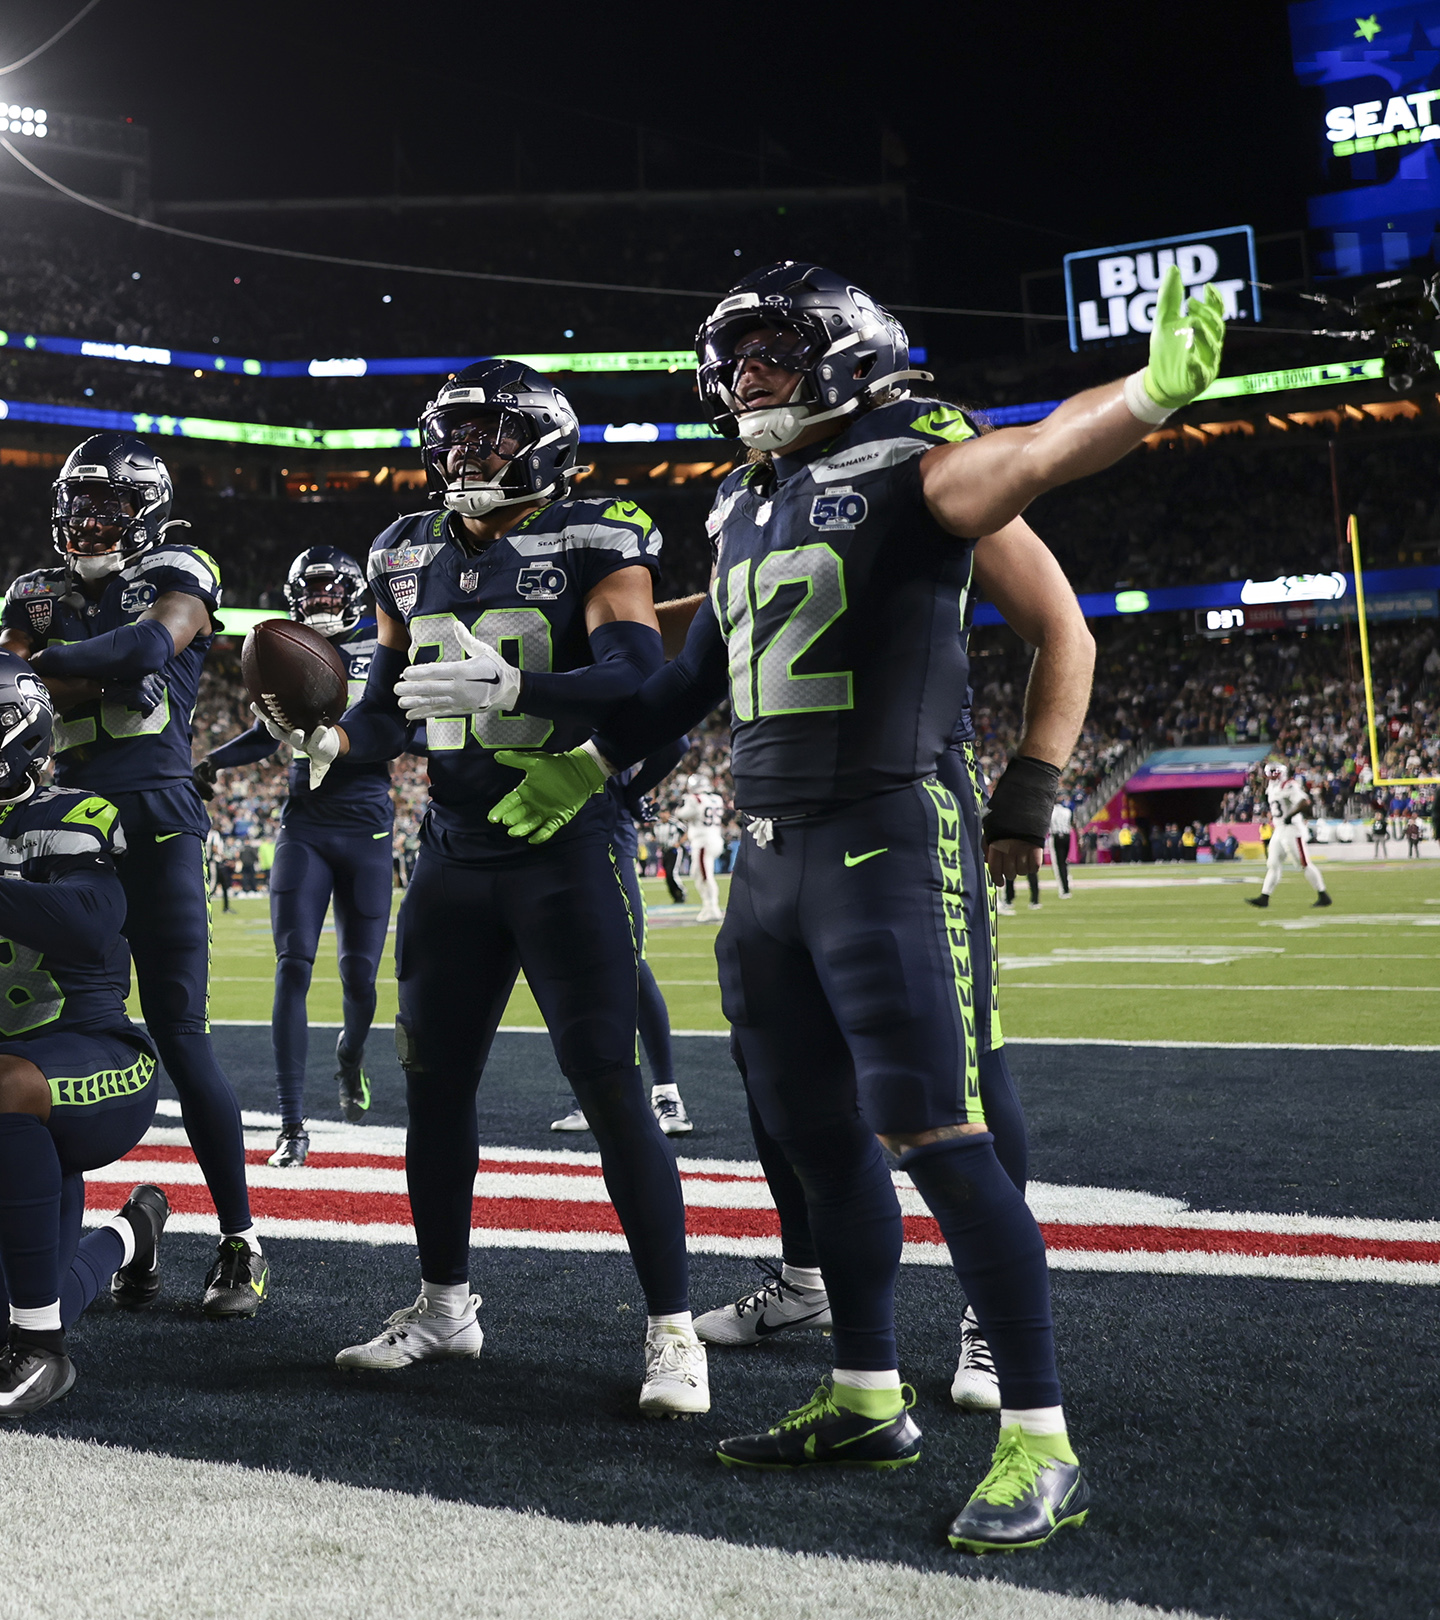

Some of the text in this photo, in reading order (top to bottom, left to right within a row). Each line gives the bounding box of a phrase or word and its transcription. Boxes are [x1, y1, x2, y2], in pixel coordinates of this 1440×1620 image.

[1326, 89, 1440, 142] SEAT
[1098, 244, 1219, 299] BUD
[827, 452, 879, 471] SEAHAWKS
[810, 492, 868, 527] 50
[392, 579, 415, 591] USA
[517, 567, 568, 597] 50
[28, 603, 50, 615] USA
[396, 594, 417, 608] 250
[31, 616, 51, 628] 250
[712, 542, 854, 721] 42
[408, 608, 555, 750] 20
